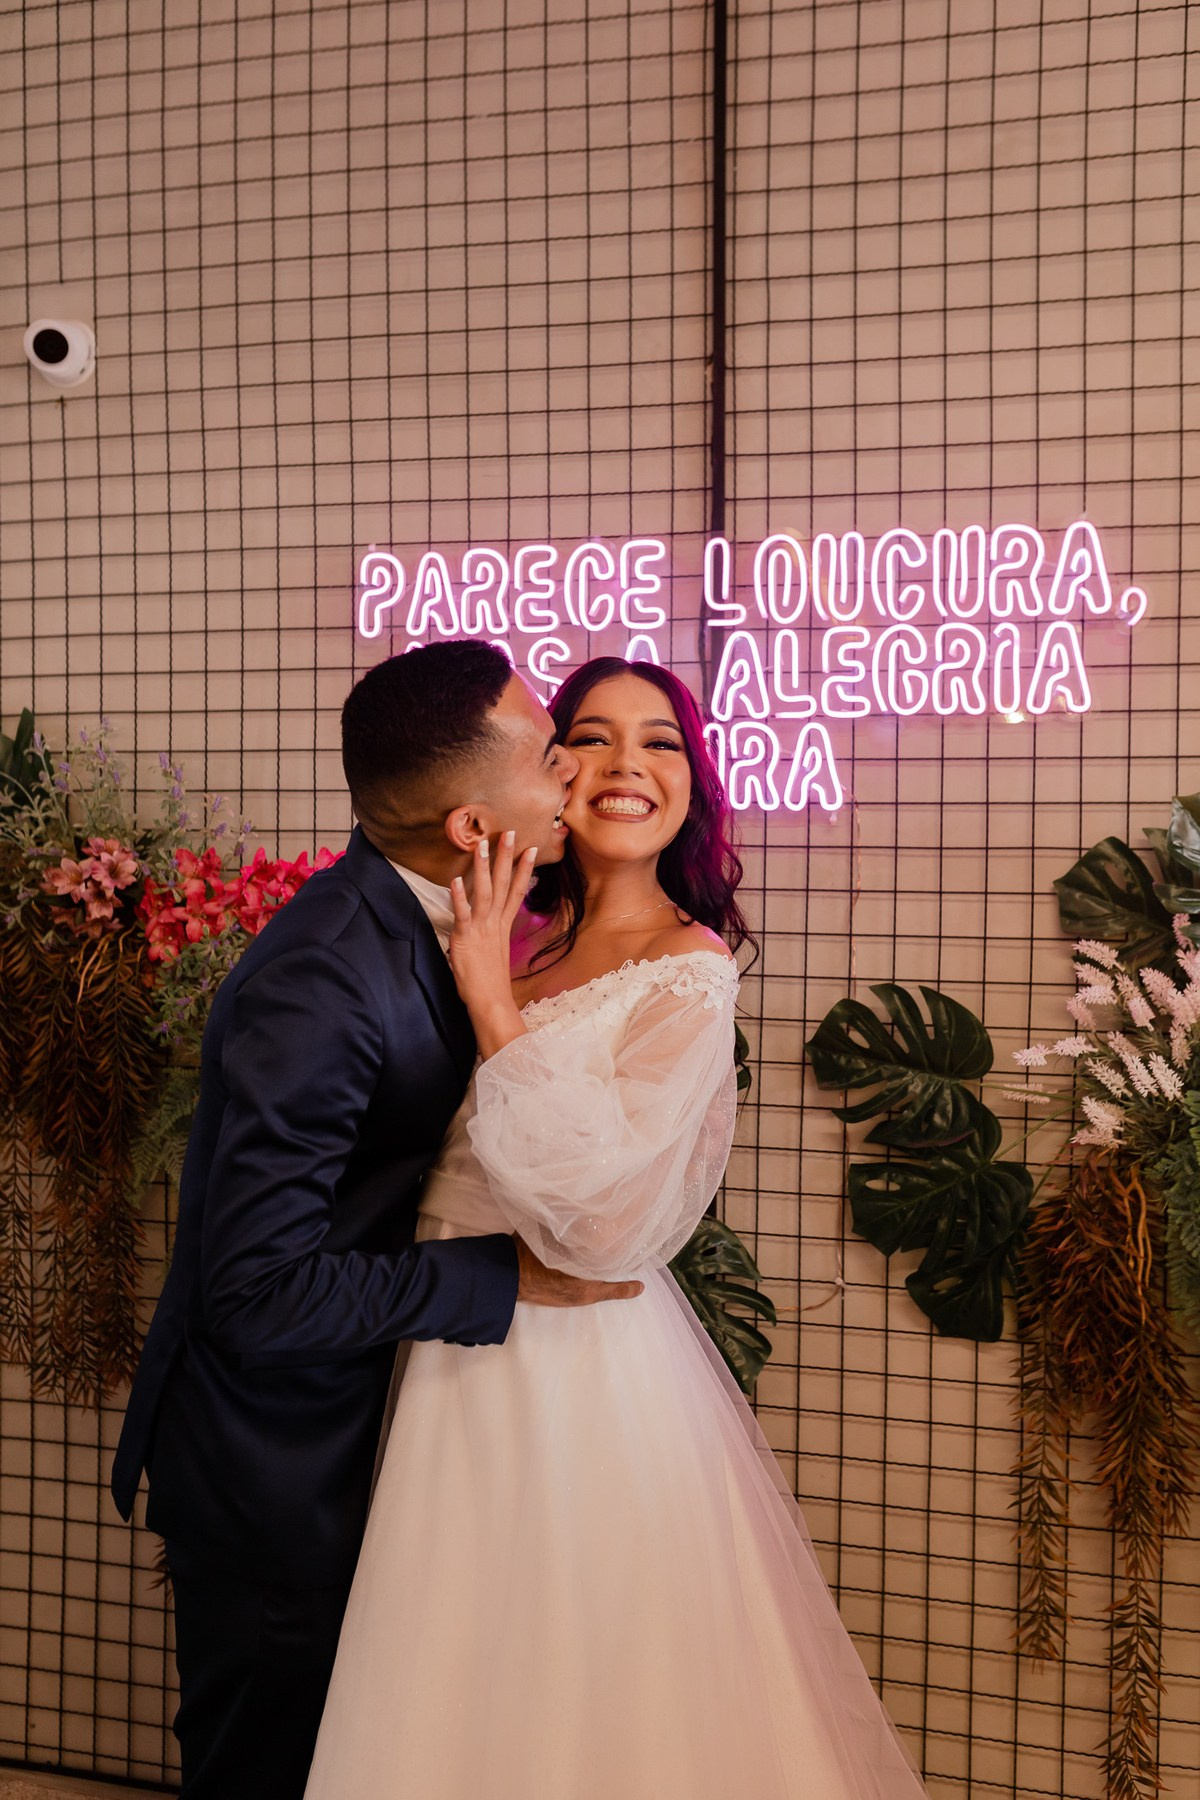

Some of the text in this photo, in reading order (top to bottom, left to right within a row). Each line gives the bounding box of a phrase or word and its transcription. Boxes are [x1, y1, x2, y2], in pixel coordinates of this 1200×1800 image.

[358, 520, 1148, 638] PARECE LOUCURA,
[710, 621, 1092, 722] ALEGRIA
